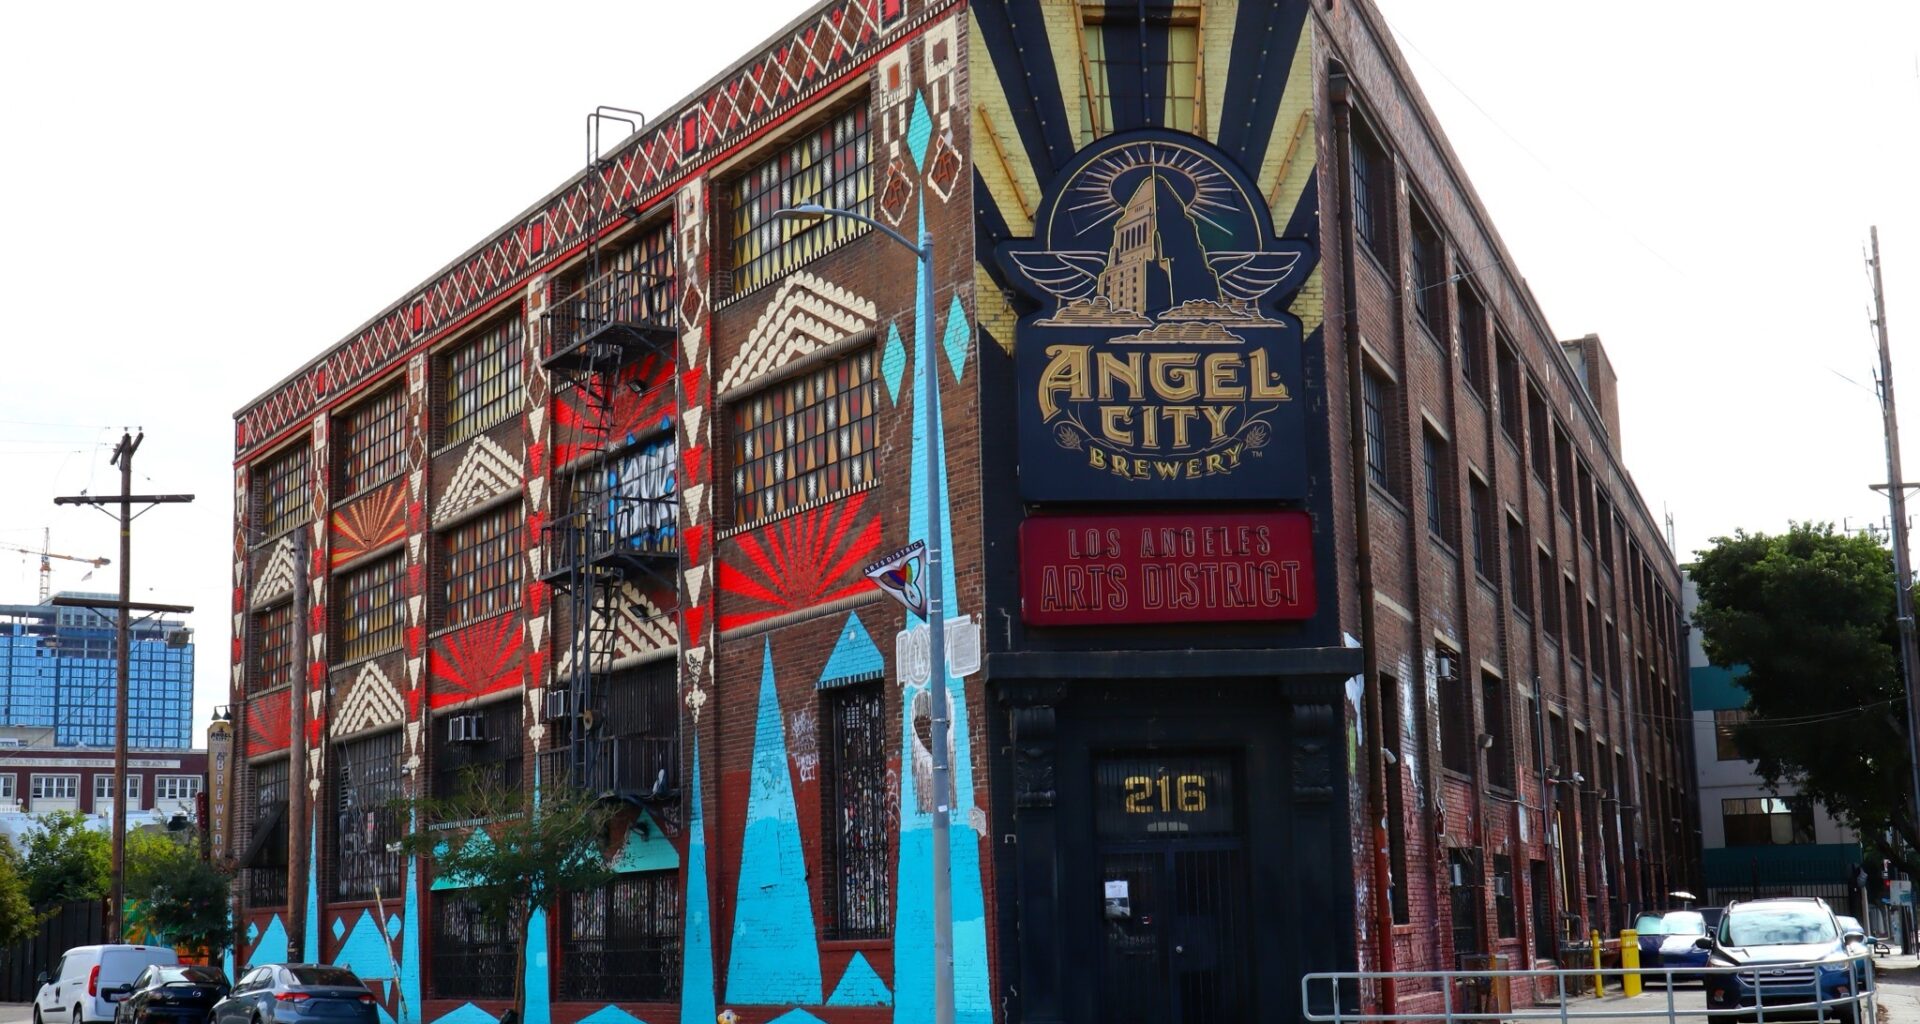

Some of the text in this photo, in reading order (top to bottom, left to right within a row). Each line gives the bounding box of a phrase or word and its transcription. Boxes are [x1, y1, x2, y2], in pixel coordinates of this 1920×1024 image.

[1038, 344, 1293, 424] ANGEL
[1100, 405, 1236, 449] CITY
[1089, 442, 1244, 481] BREWERY
[864, 540, 924, 575] ARTS DISTRICT
[1068, 526, 1271, 559] LOS ANGELES
[1040, 561, 1300, 612] ARTS DISTRICT
[1124, 775, 1207, 814] 216
